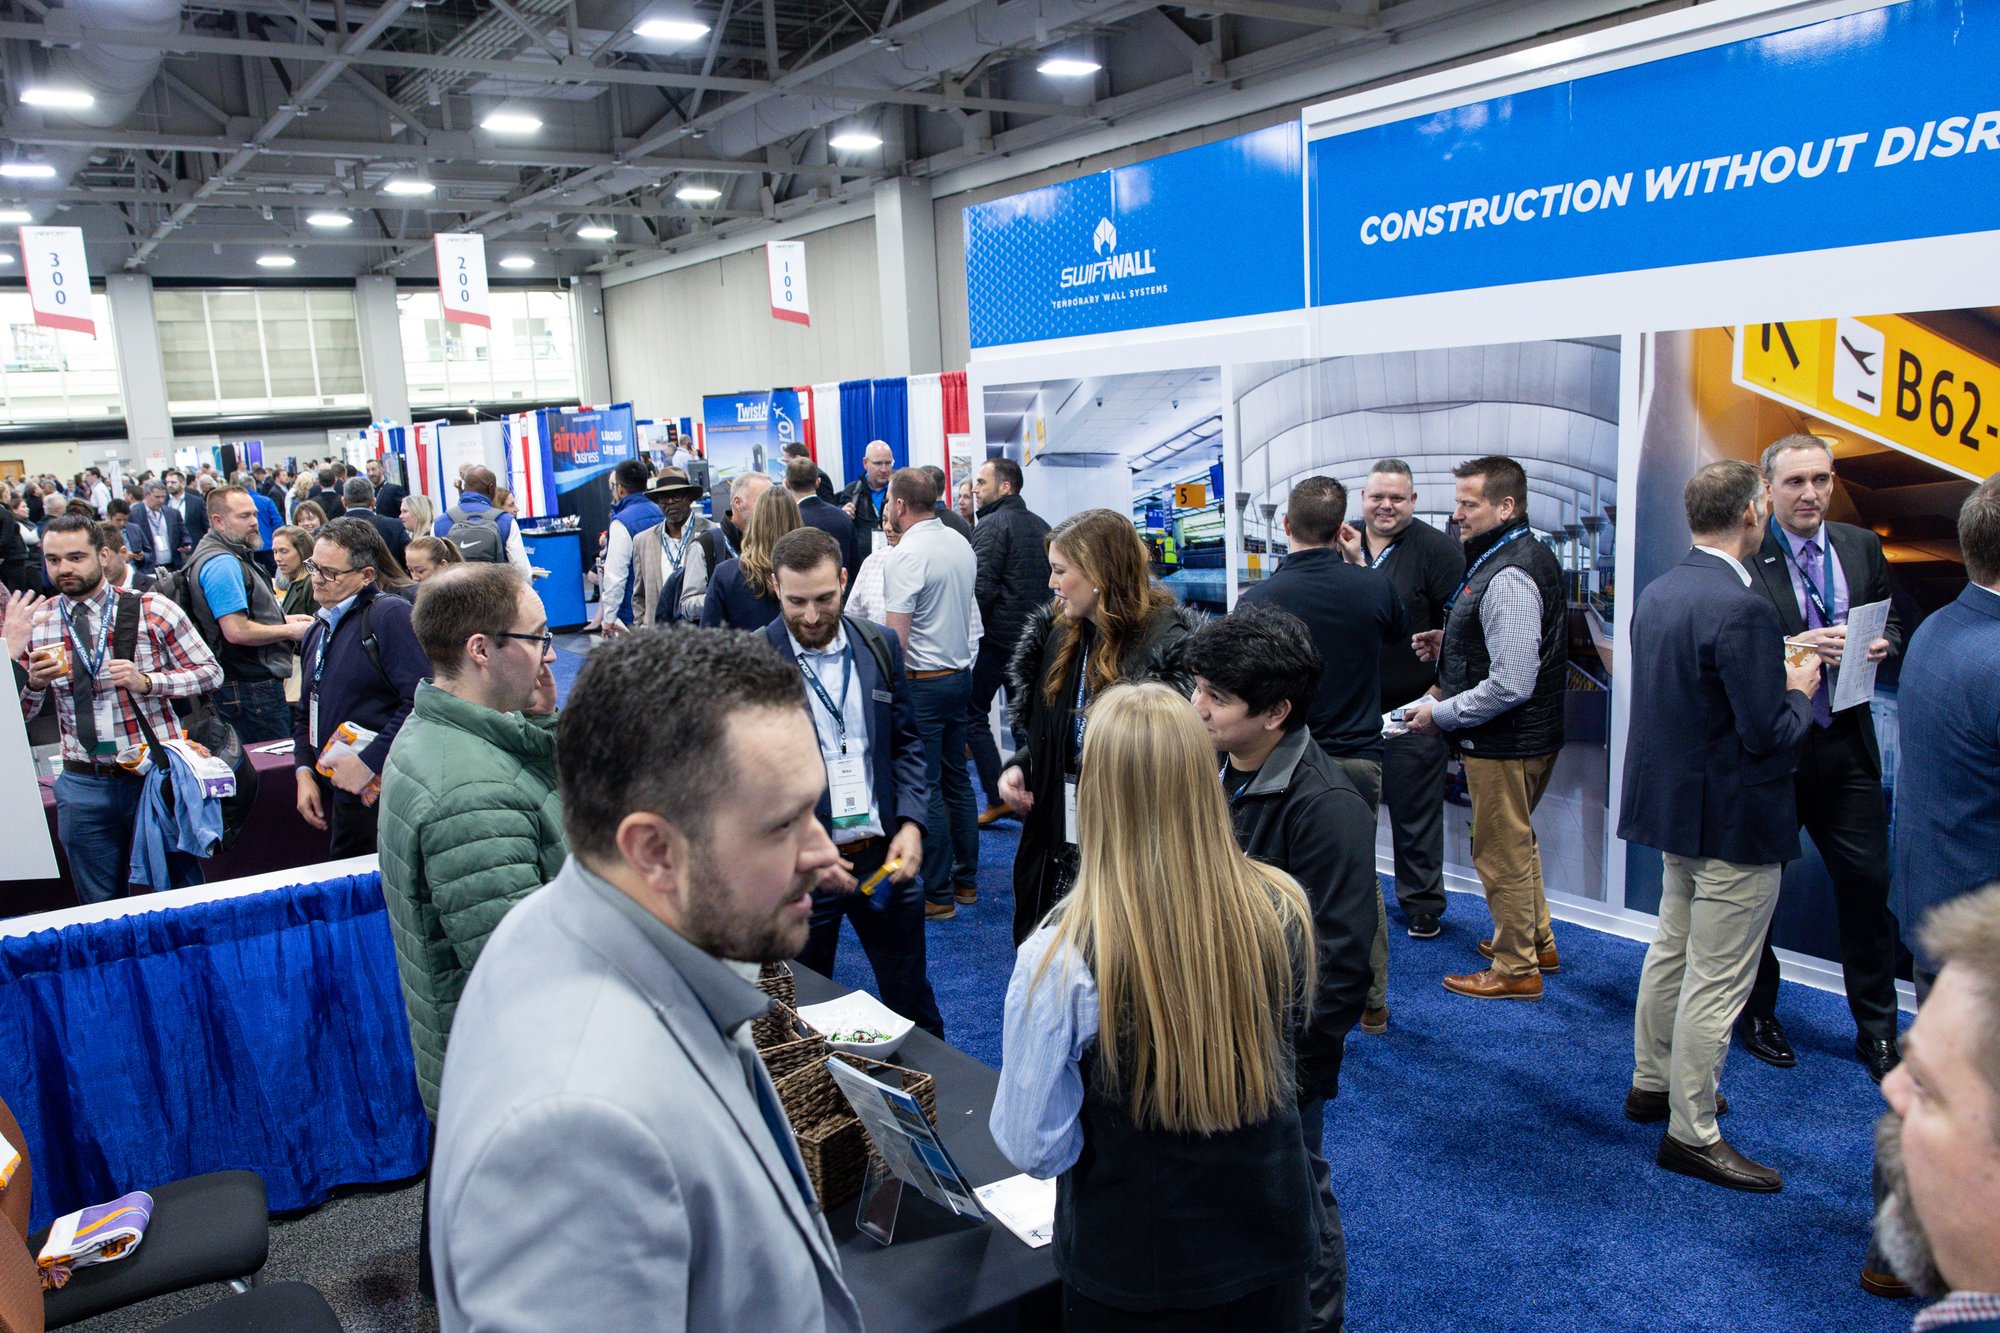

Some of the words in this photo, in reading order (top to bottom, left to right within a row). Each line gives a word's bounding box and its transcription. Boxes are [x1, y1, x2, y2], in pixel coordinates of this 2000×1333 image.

[1359, 171, 1635, 246] CONSTRUCTION
[1643, 131, 1869, 202] WITHOUT
[1873, 109, 2000, 168] DISR
[1060, 248, 1157, 289] SWIFTWALL
[1052, 294, 1100, 310] TEMPORARY
[1103, 290, 1126, 302] WALL
[1129, 284, 1169, 298] SYSTEMS
[553, 424, 598, 459] airport
[574, 450, 600, 464] business
[1180, 487, 1188, 505] 5
